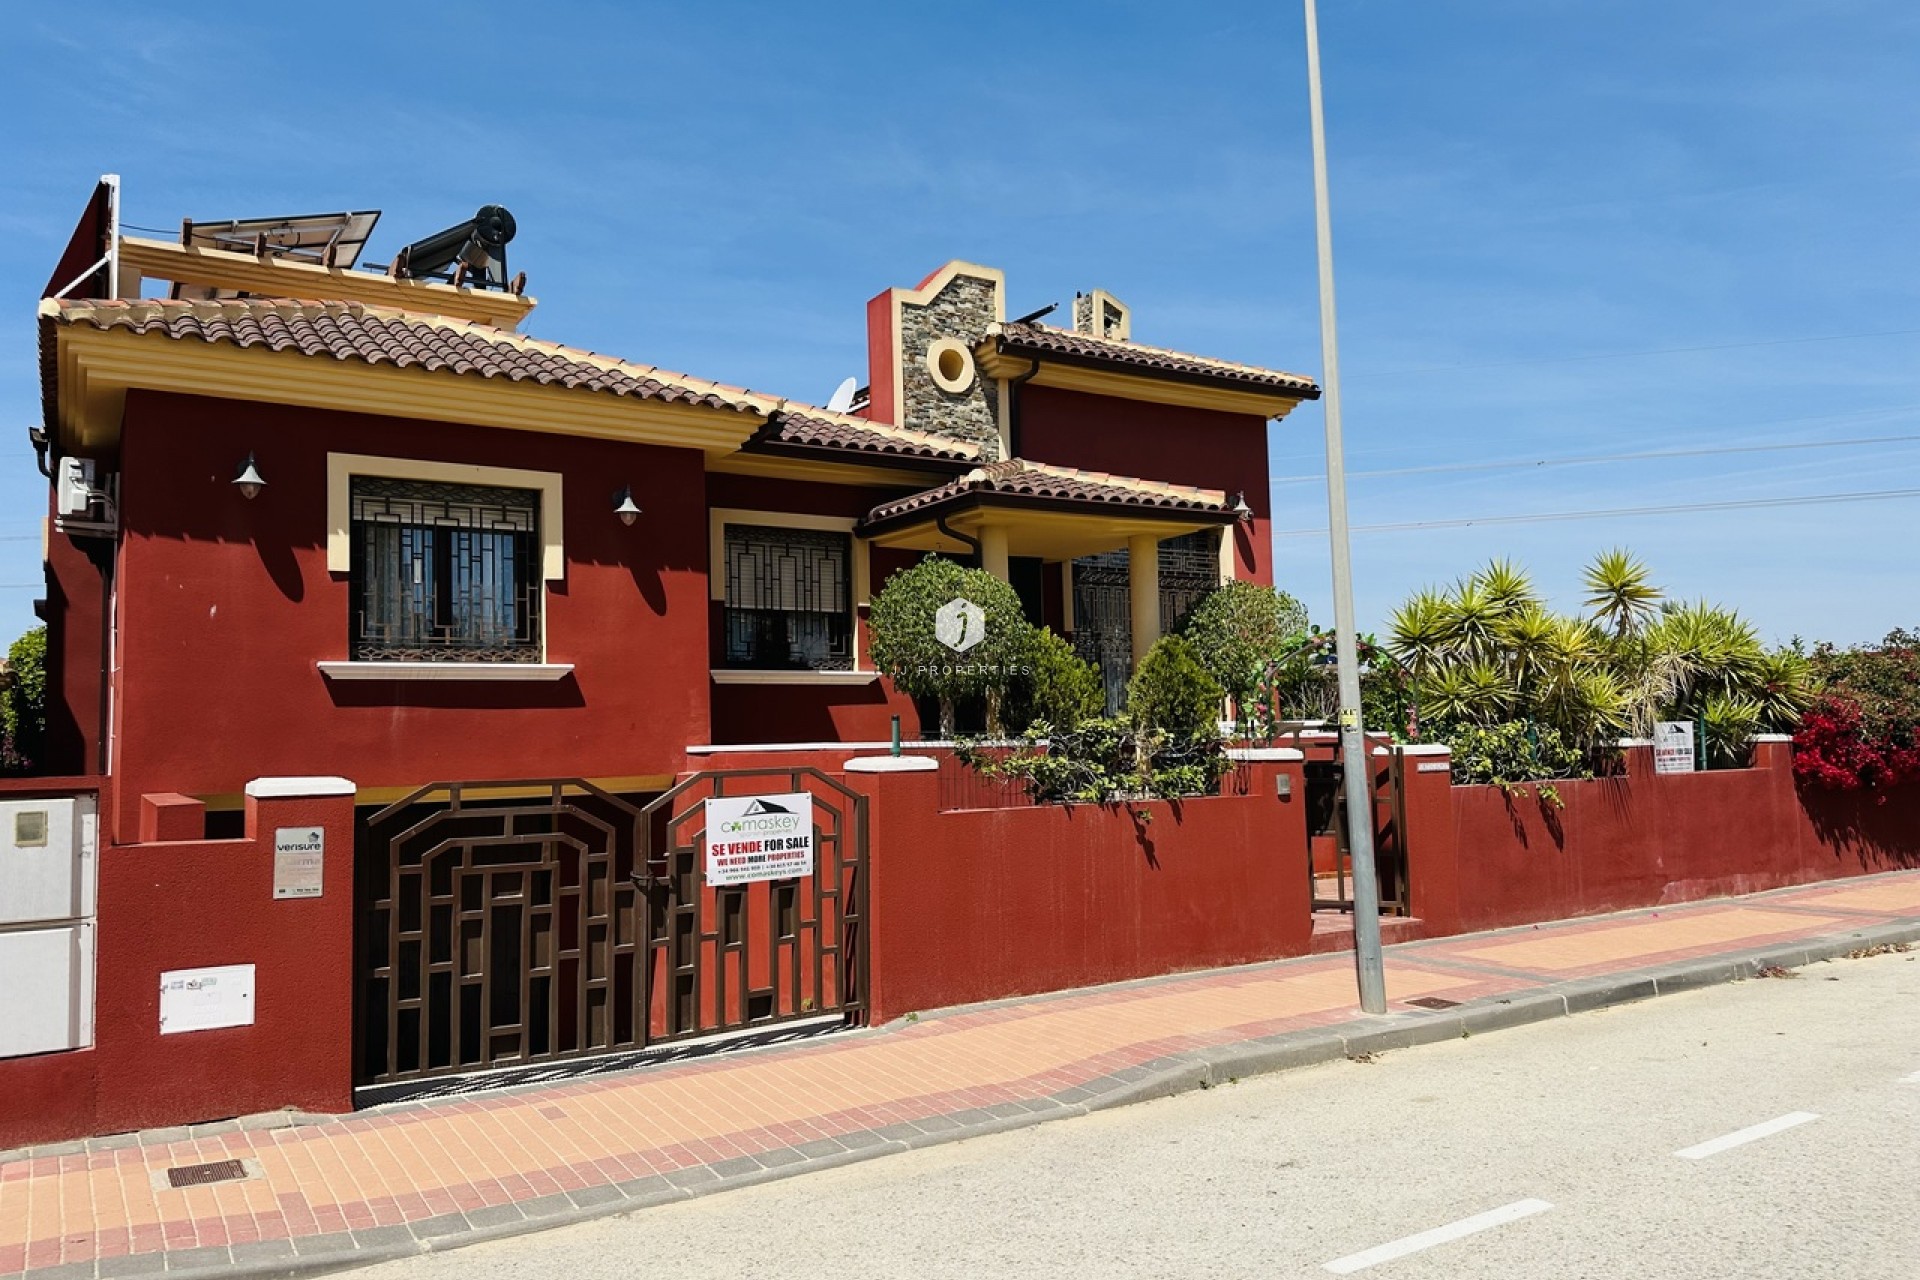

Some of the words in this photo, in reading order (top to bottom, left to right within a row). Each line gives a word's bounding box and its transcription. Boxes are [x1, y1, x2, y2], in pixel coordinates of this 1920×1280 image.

[277, 843, 321, 852] verisure
[711, 843, 726, 856] SE
[728, 840, 763, 855] VENDE
[764, 838, 784, 852] FOR
[786, 836, 809, 850] SALE
[717, 858, 728, 867] WE
[730, 857, 746, 866] NEED
[747, 854, 766, 863] MORE
[768, 850, 805, 862] PROPERTIES
